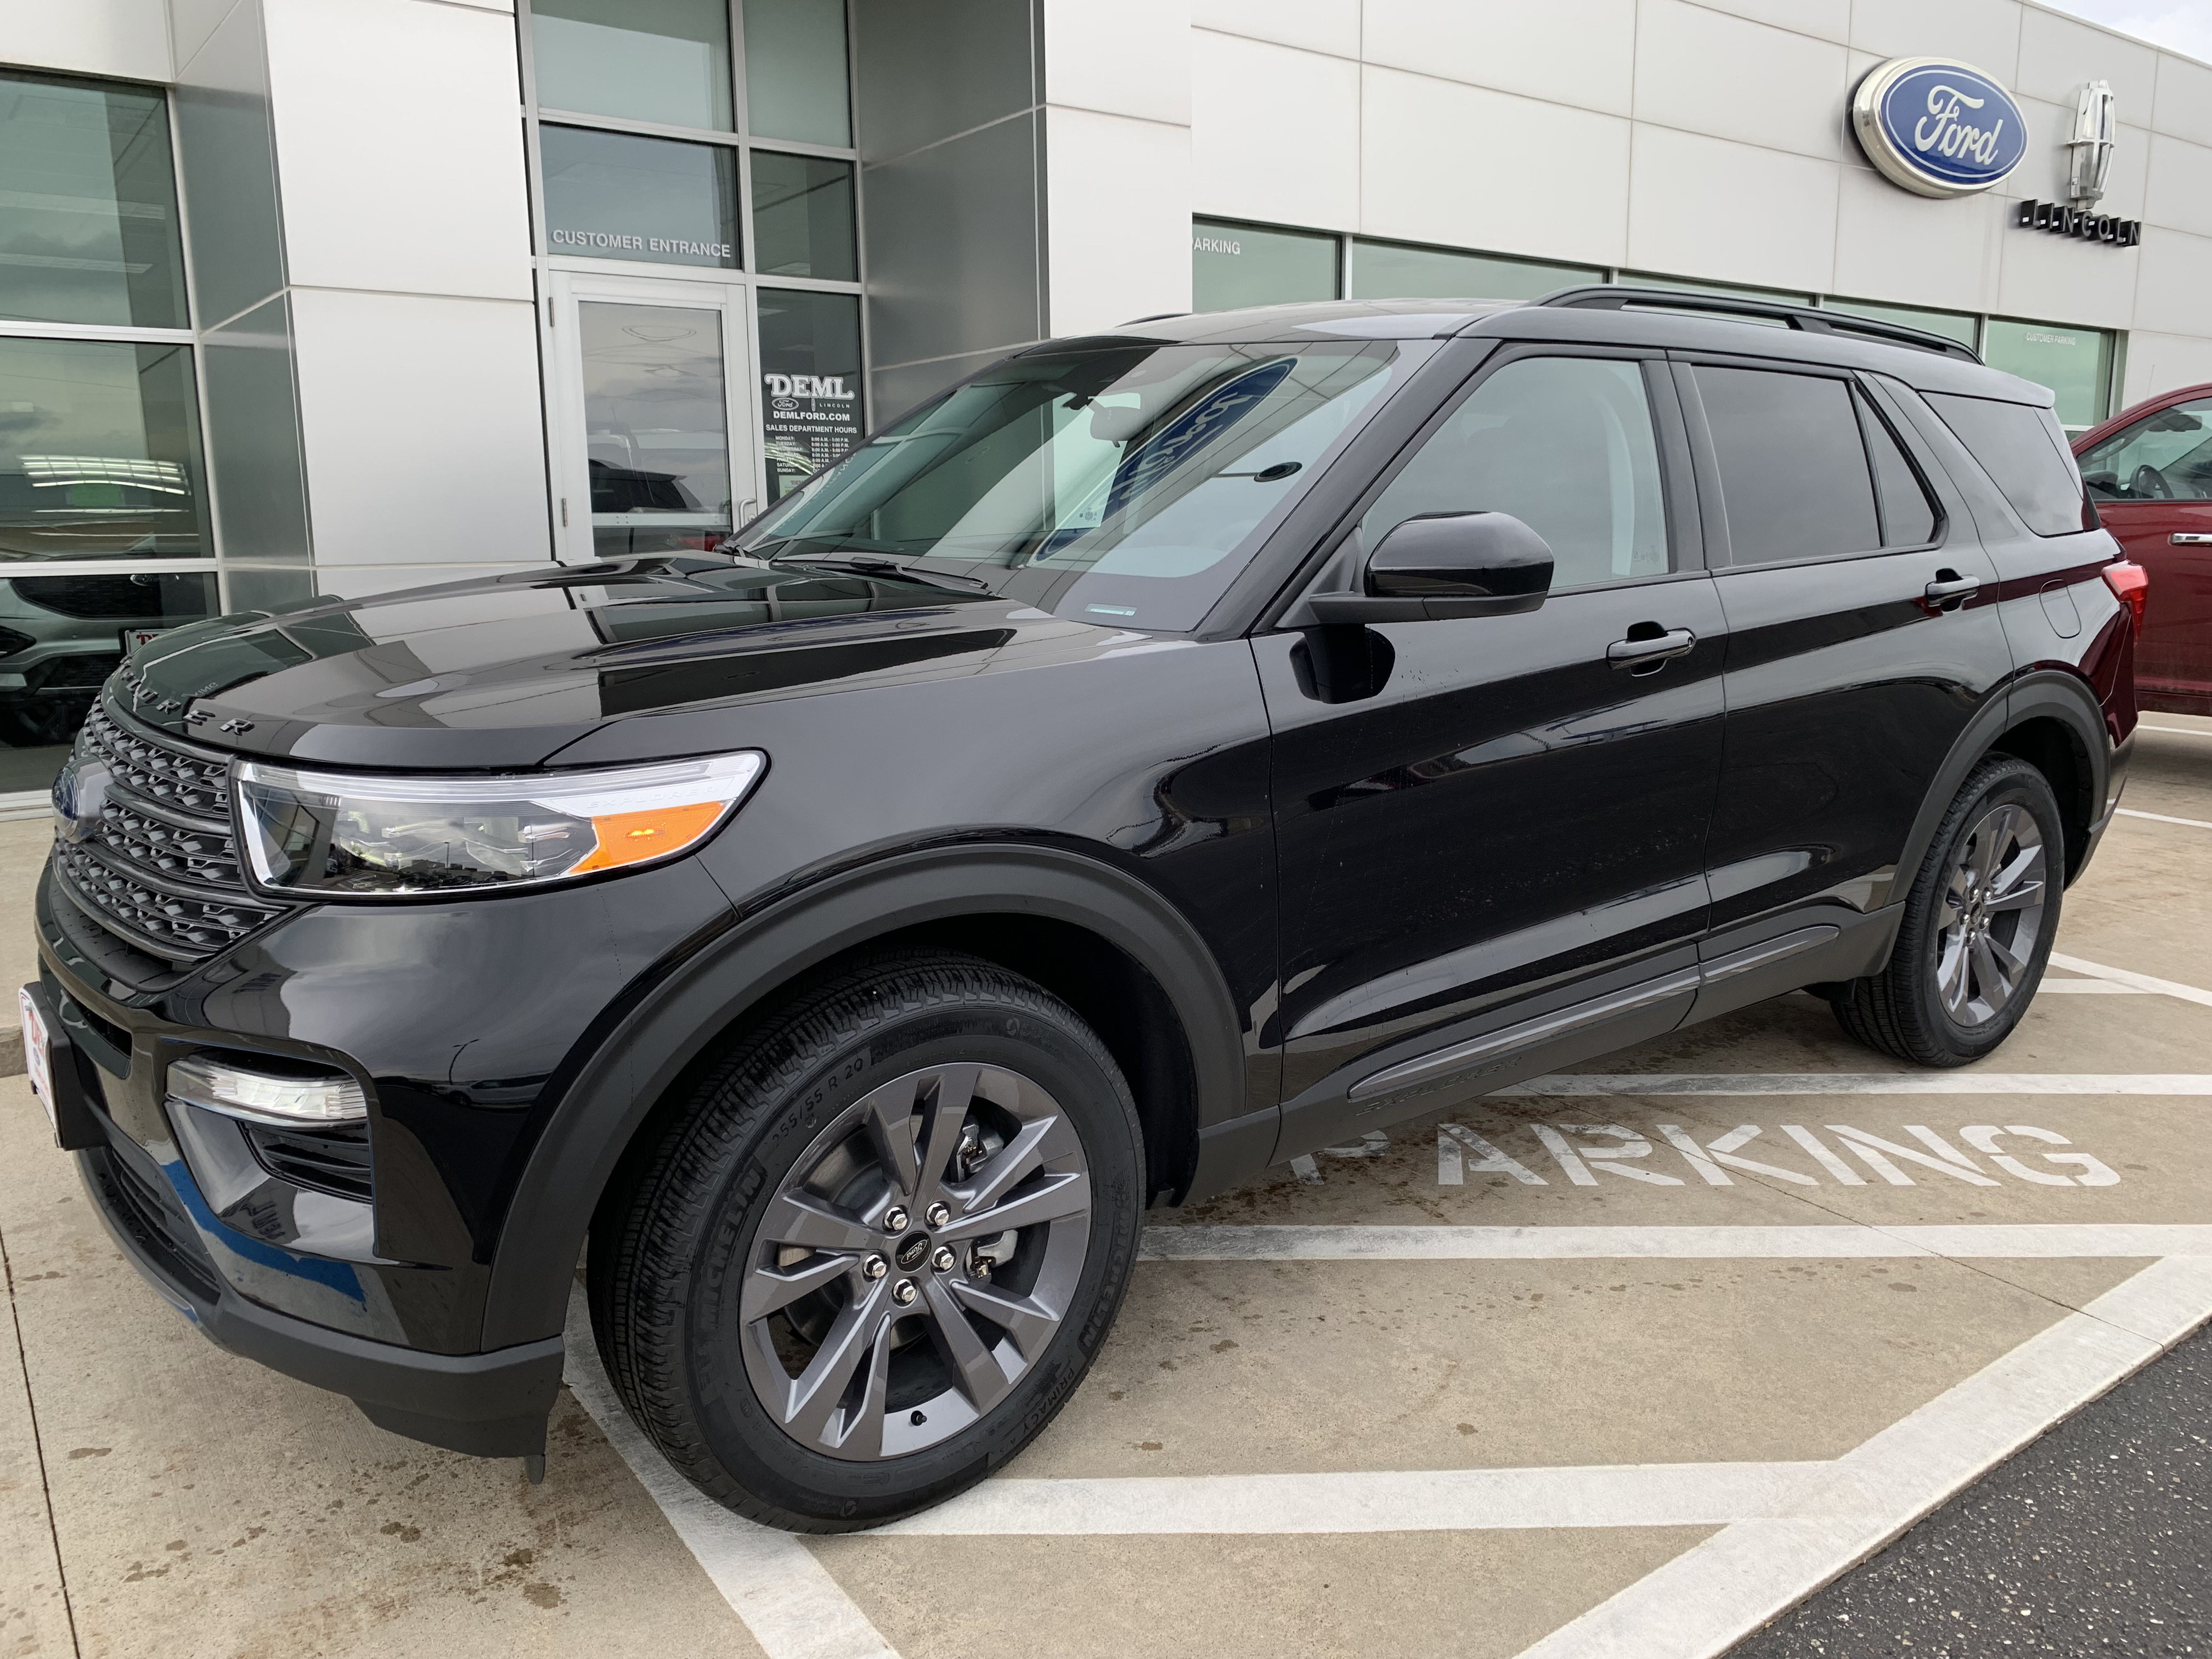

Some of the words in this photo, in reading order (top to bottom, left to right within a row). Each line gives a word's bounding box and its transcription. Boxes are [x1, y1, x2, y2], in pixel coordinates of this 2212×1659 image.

[1914, 84, 2004, 166] Ford
[2021, 199, 2141, 246] LINCOLN
[552, 229, 642, 250] CUSTOMER
[649, 238, 731, 257] ENTRANCE
[1192, 236, 1241, 255] ARKING
[2026, 332, 2053, 343] CUSTOMER
[2054, 335, 2076, 346] PARKING
[764, 374, 855, 400] DEML
[773, 411, 850, 421] DEMLFORD.COM
[777, 399, 793, 408] Ford
[789, 425, 833, 433] DEPARTMENT
[586, 786, 716, 809] EXPLORER
[1355, 1056, 1522, 1116] EXPLORER
[772, 1087, 823, 1148] 255/55
[828, 1075, 838, 1092] R
[845, 1058, 864, 1080] 20
[699, 1167, 761, 1328] MICHELIN
[906, 1242, 923, 1261] Ford
[1084, 1211, 1131, 1348] MICHELIN
[1022, 1367, 1075, 1435] PRIMACY
